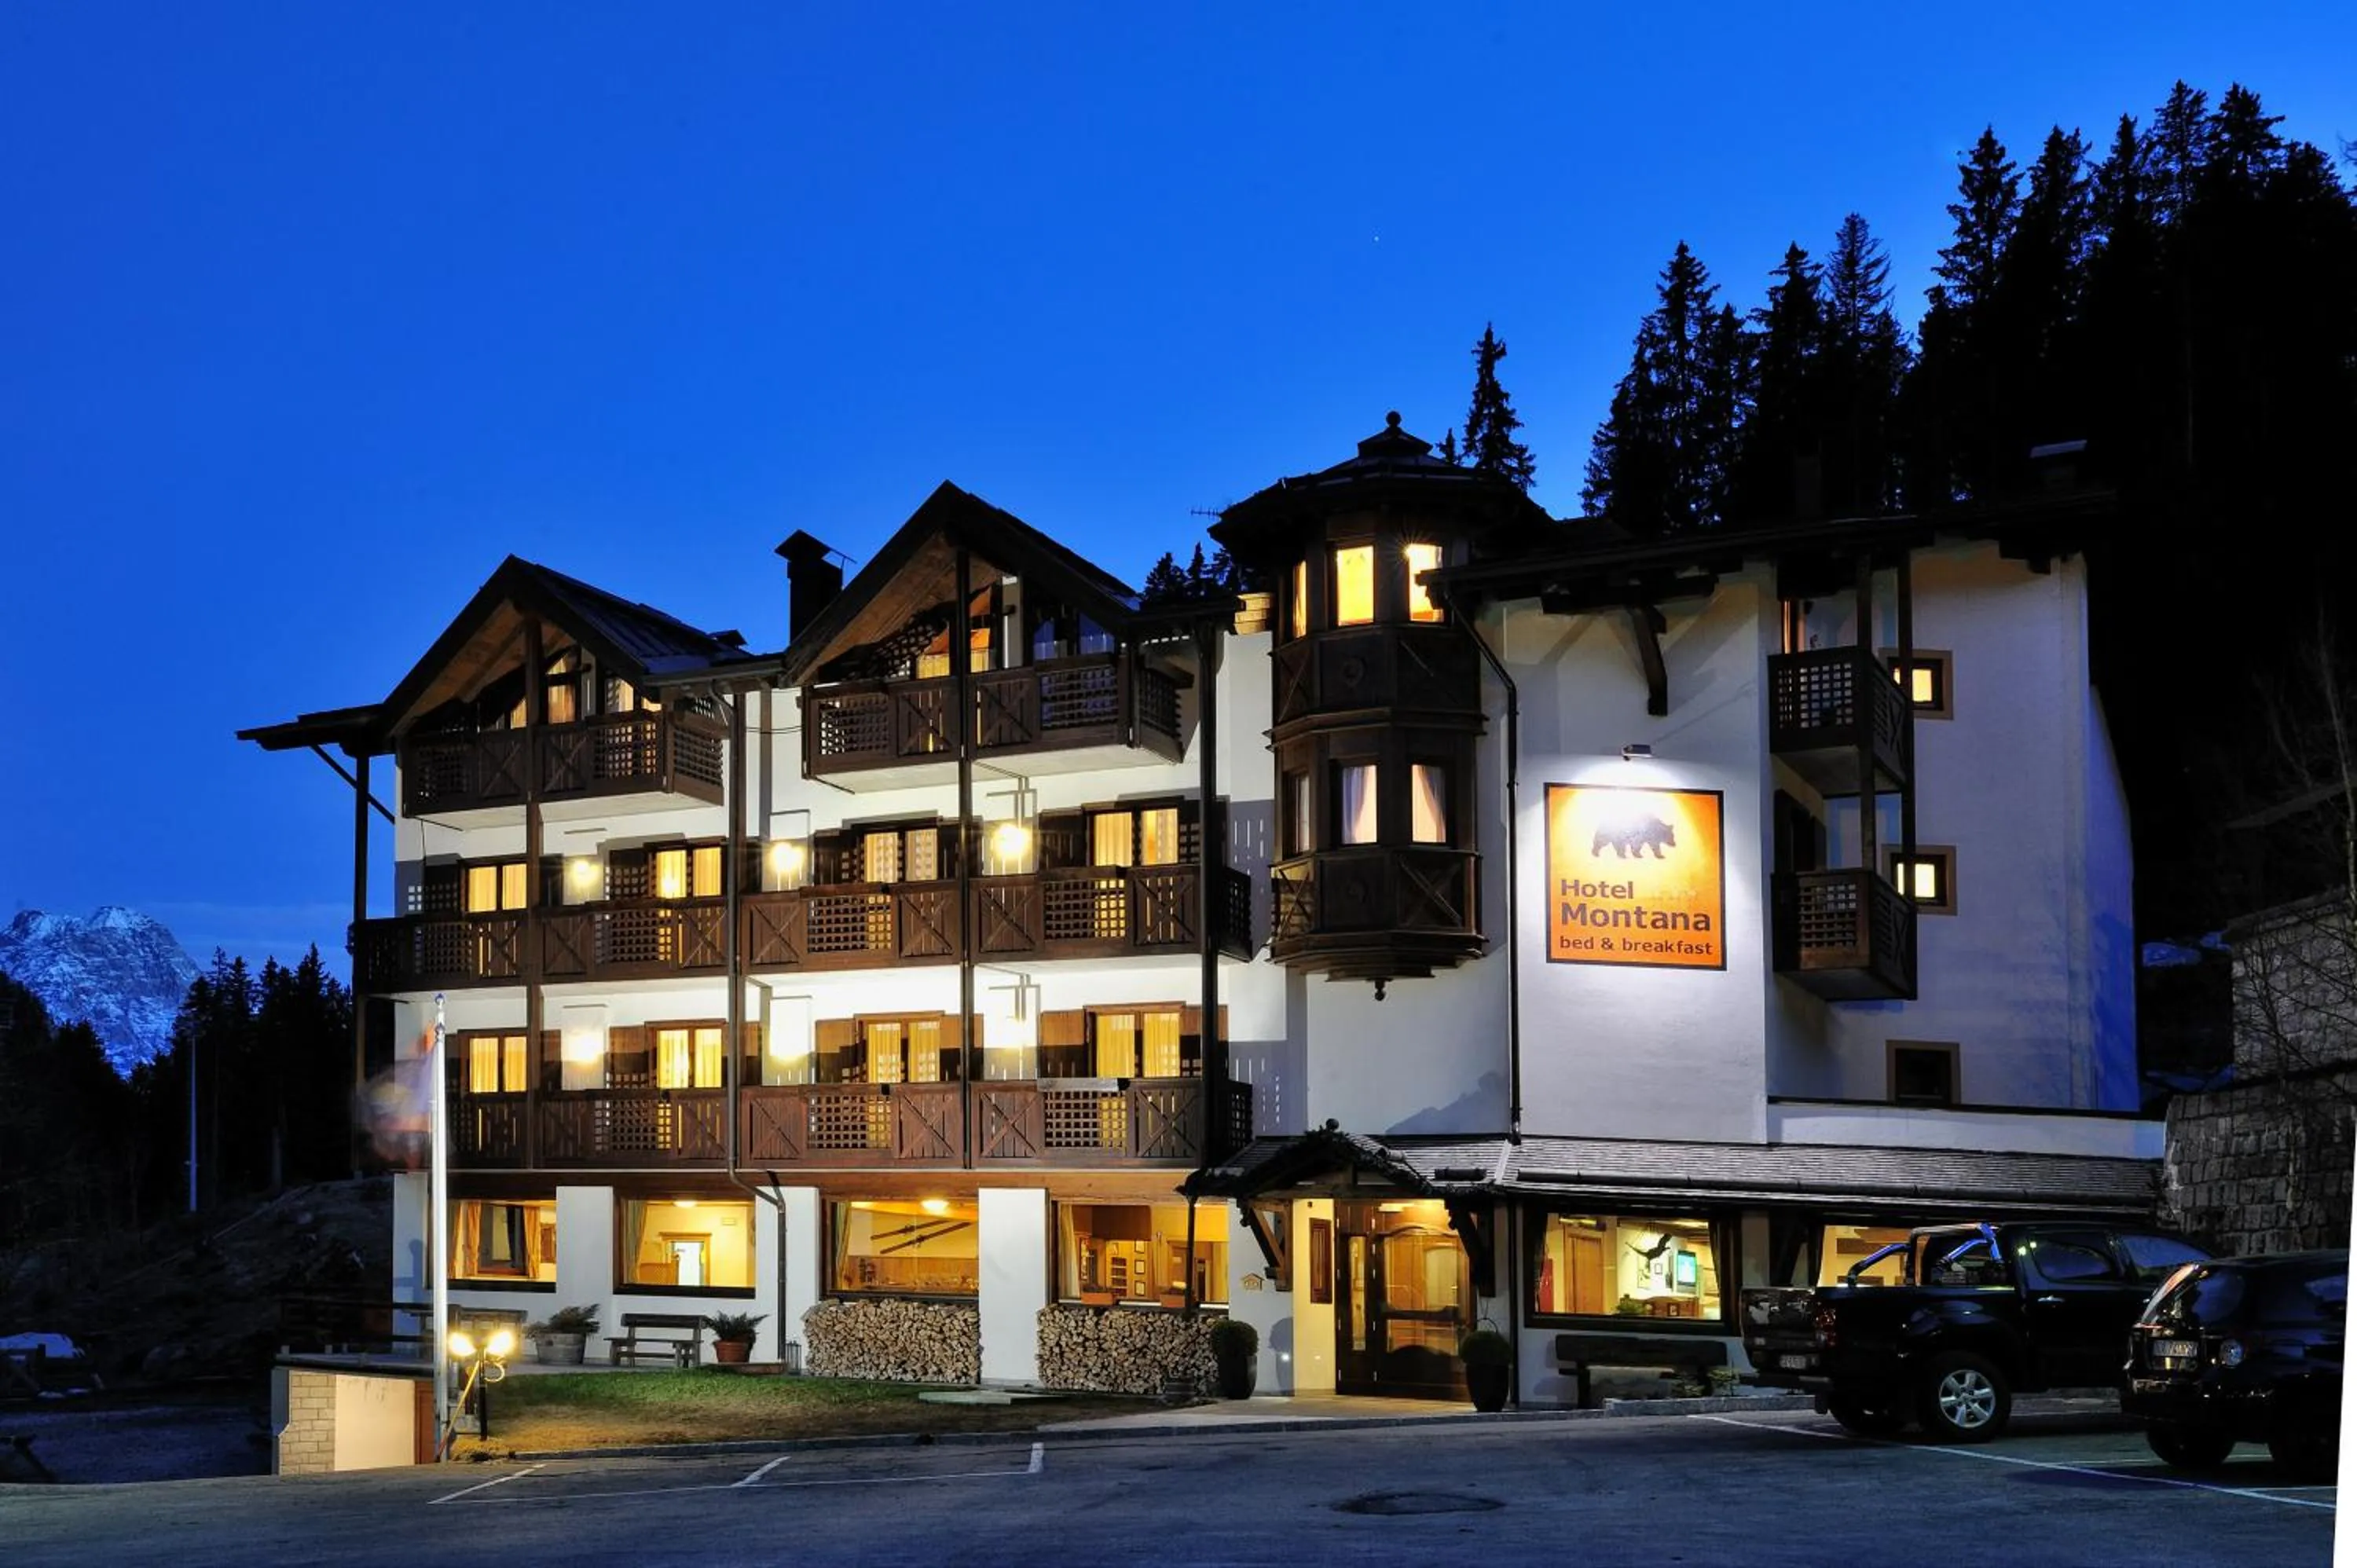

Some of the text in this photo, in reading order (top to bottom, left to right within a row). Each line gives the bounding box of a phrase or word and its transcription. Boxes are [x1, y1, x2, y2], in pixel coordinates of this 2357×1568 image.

[1560, 879, 1634, 899] Hotel
[1561, 902, 1711, 932] Montana
[1560, 936, 1713, 955] bed & breakfast
